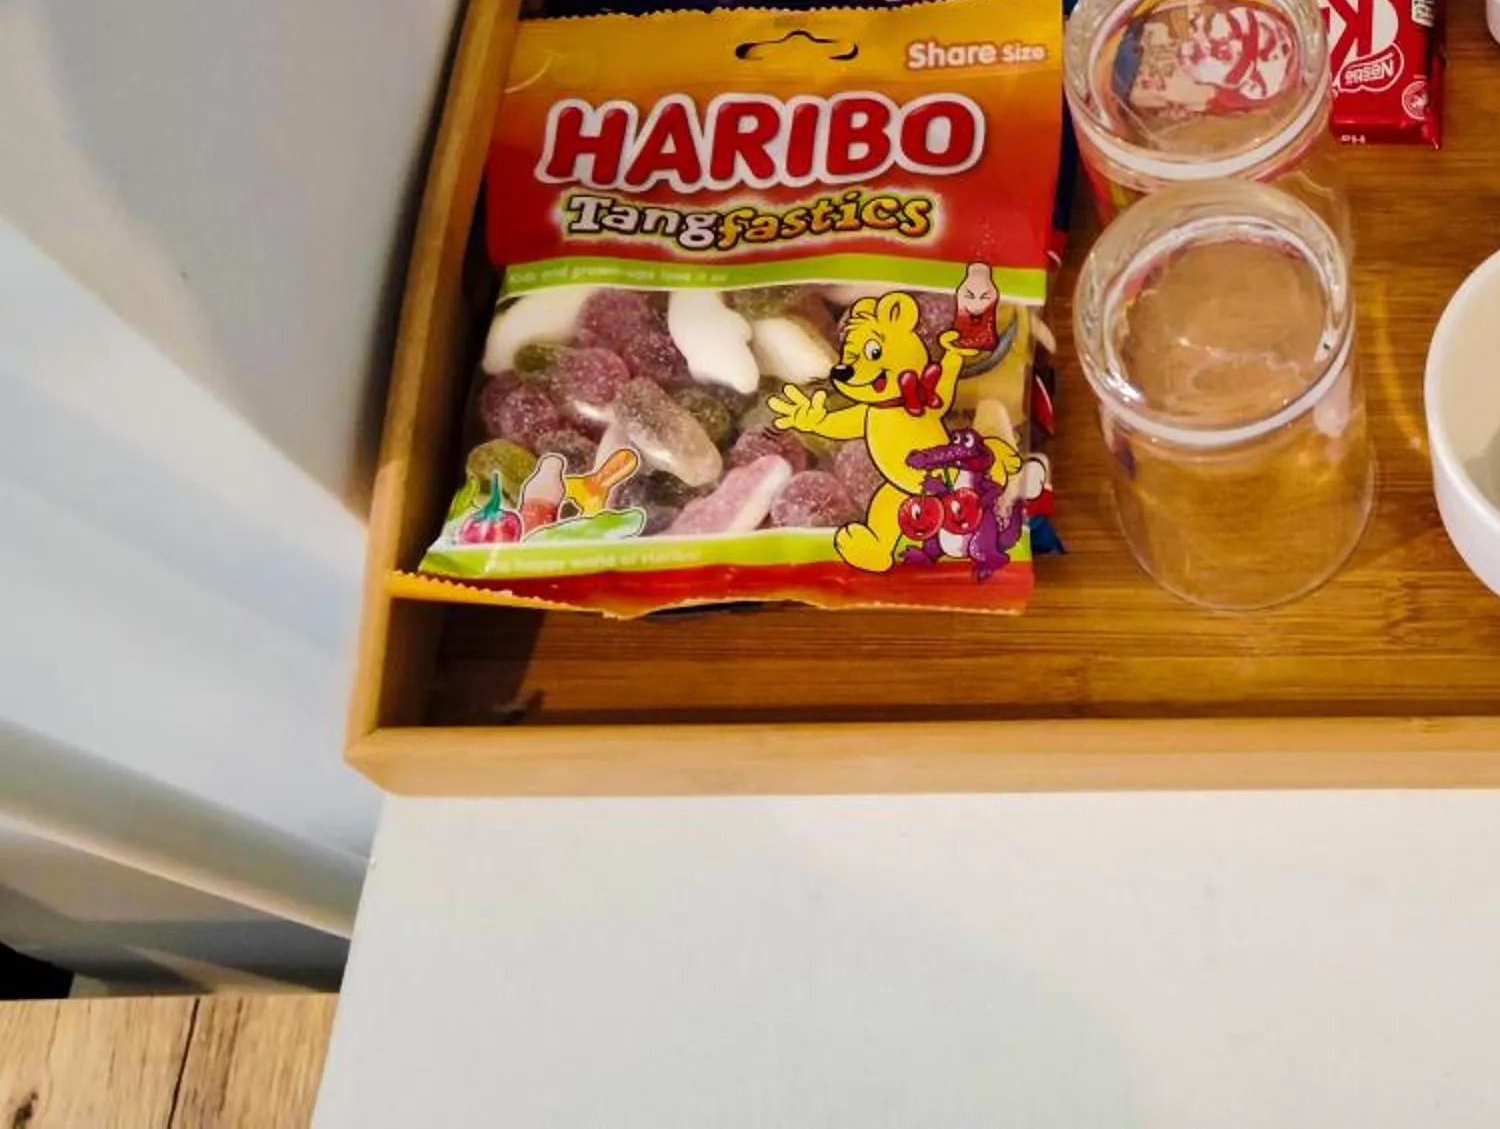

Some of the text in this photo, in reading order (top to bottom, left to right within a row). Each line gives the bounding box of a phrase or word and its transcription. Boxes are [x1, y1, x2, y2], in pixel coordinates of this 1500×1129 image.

[906, 40, 1047, 70] Share Size
[538, 93, 985, 191] HARIBO
[565, 189, 936, 250] Tangfastics
